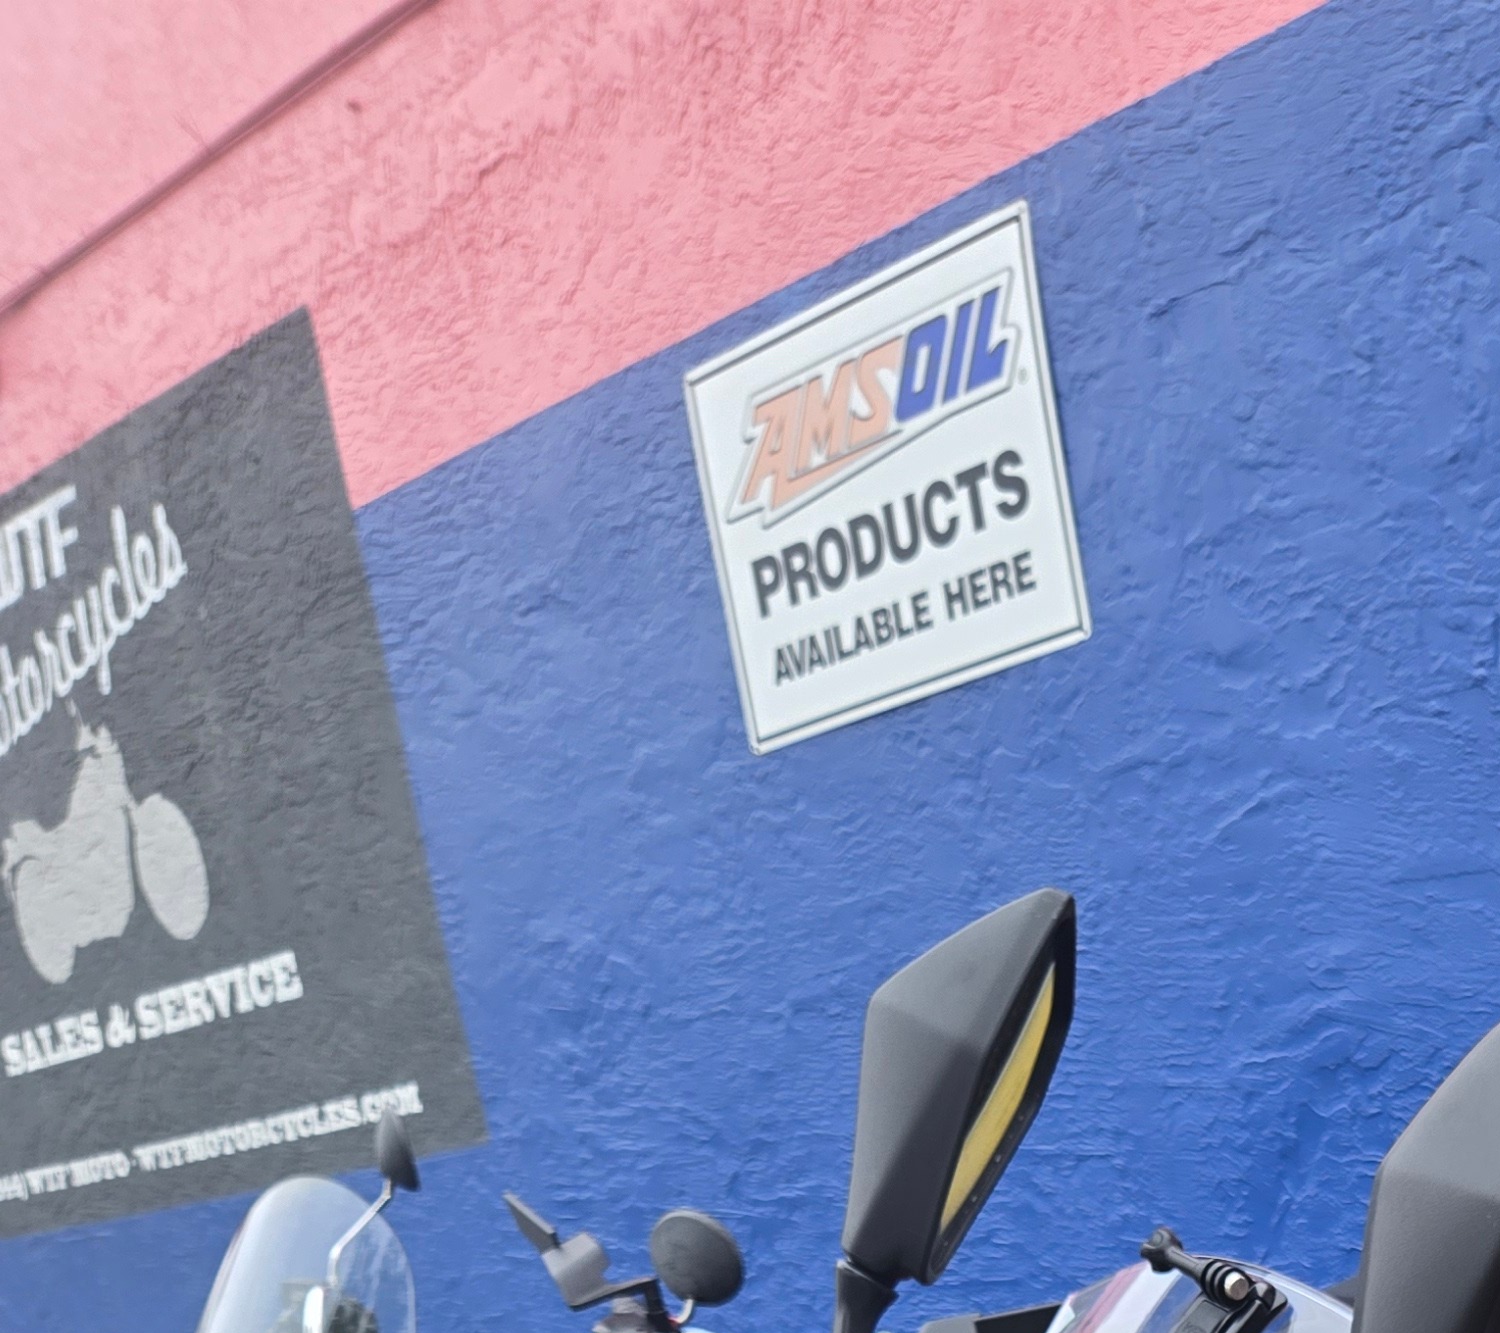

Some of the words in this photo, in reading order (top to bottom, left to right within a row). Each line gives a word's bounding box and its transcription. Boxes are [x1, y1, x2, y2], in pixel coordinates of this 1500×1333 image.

[739, 284, 1008, 512] AMSOIL
[752, 449, 1030, 618] PRODUCTS
[774, 591, 935, 686] AVAILABLE
[942, 550, 1038, 621] HERE
[2, 1008, 104, 1077] SALES
[105, 1003, 136, 1048] &
[134, 948, 304, 1040] SERVICE
